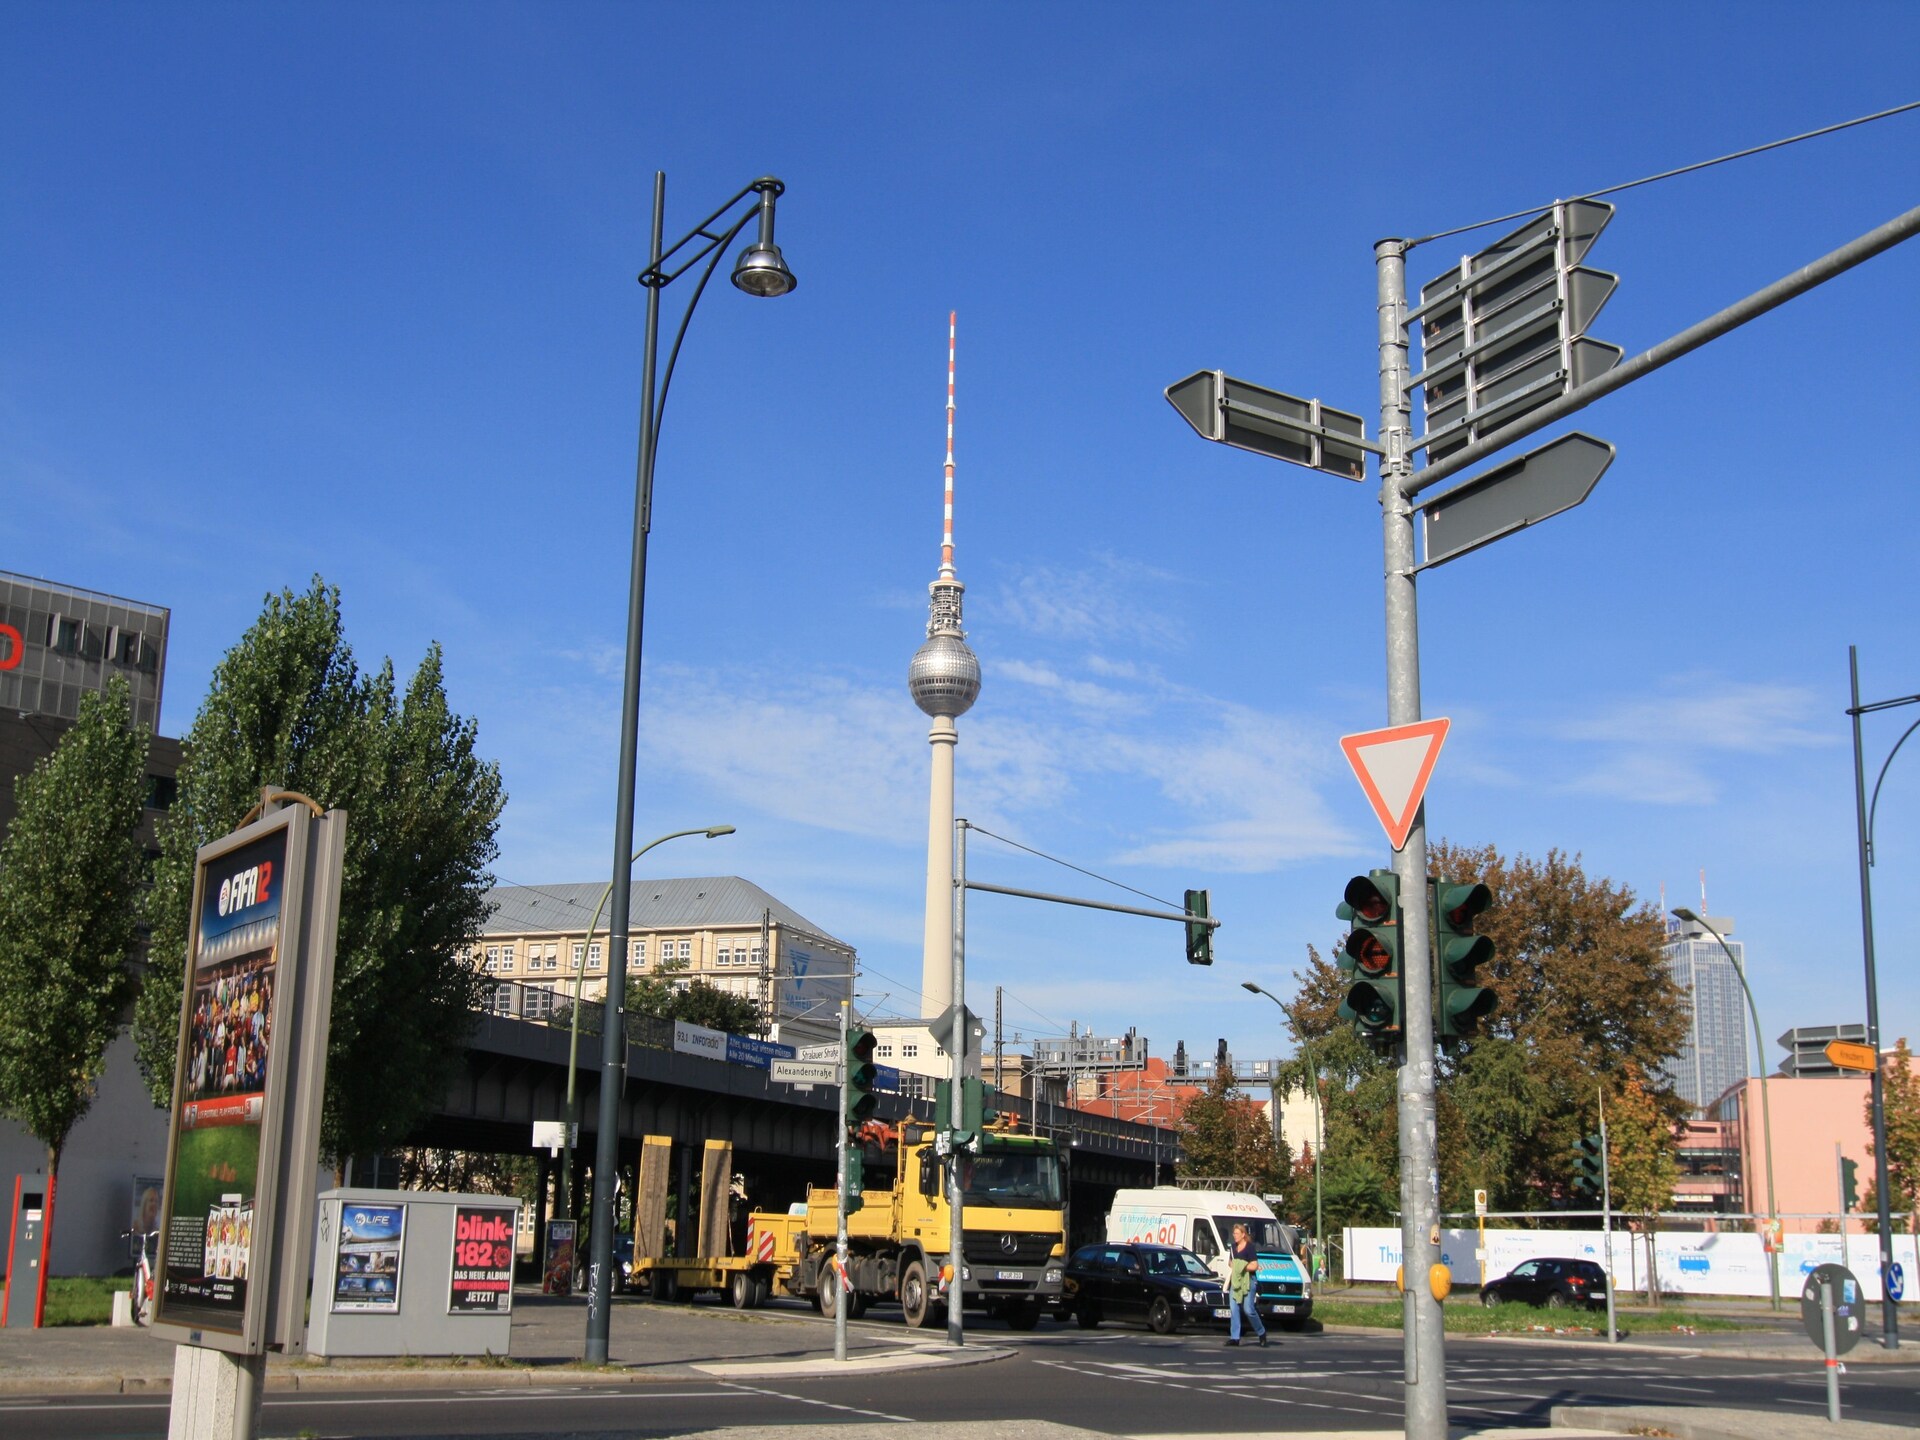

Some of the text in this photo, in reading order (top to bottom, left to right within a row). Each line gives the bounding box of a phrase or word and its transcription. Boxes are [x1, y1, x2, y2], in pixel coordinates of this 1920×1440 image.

[229, 861, 273, 914] FIFA 12
[677, 1031, 689, 1043] 93,1
[802, 1047, 839, 1060] Stralauer Straße
[776, 1066, 832, 1079] Alexanderstraße
[366, 1216, 390, 1225] LIFE
[457, 1215, 513, 1241] blink-
[456, 1242, 493, 1267] 182
[454, 1271, 510, 1280] DAS NEUE ALBUM
[465, 1292, 495, 1302] JETZT!
